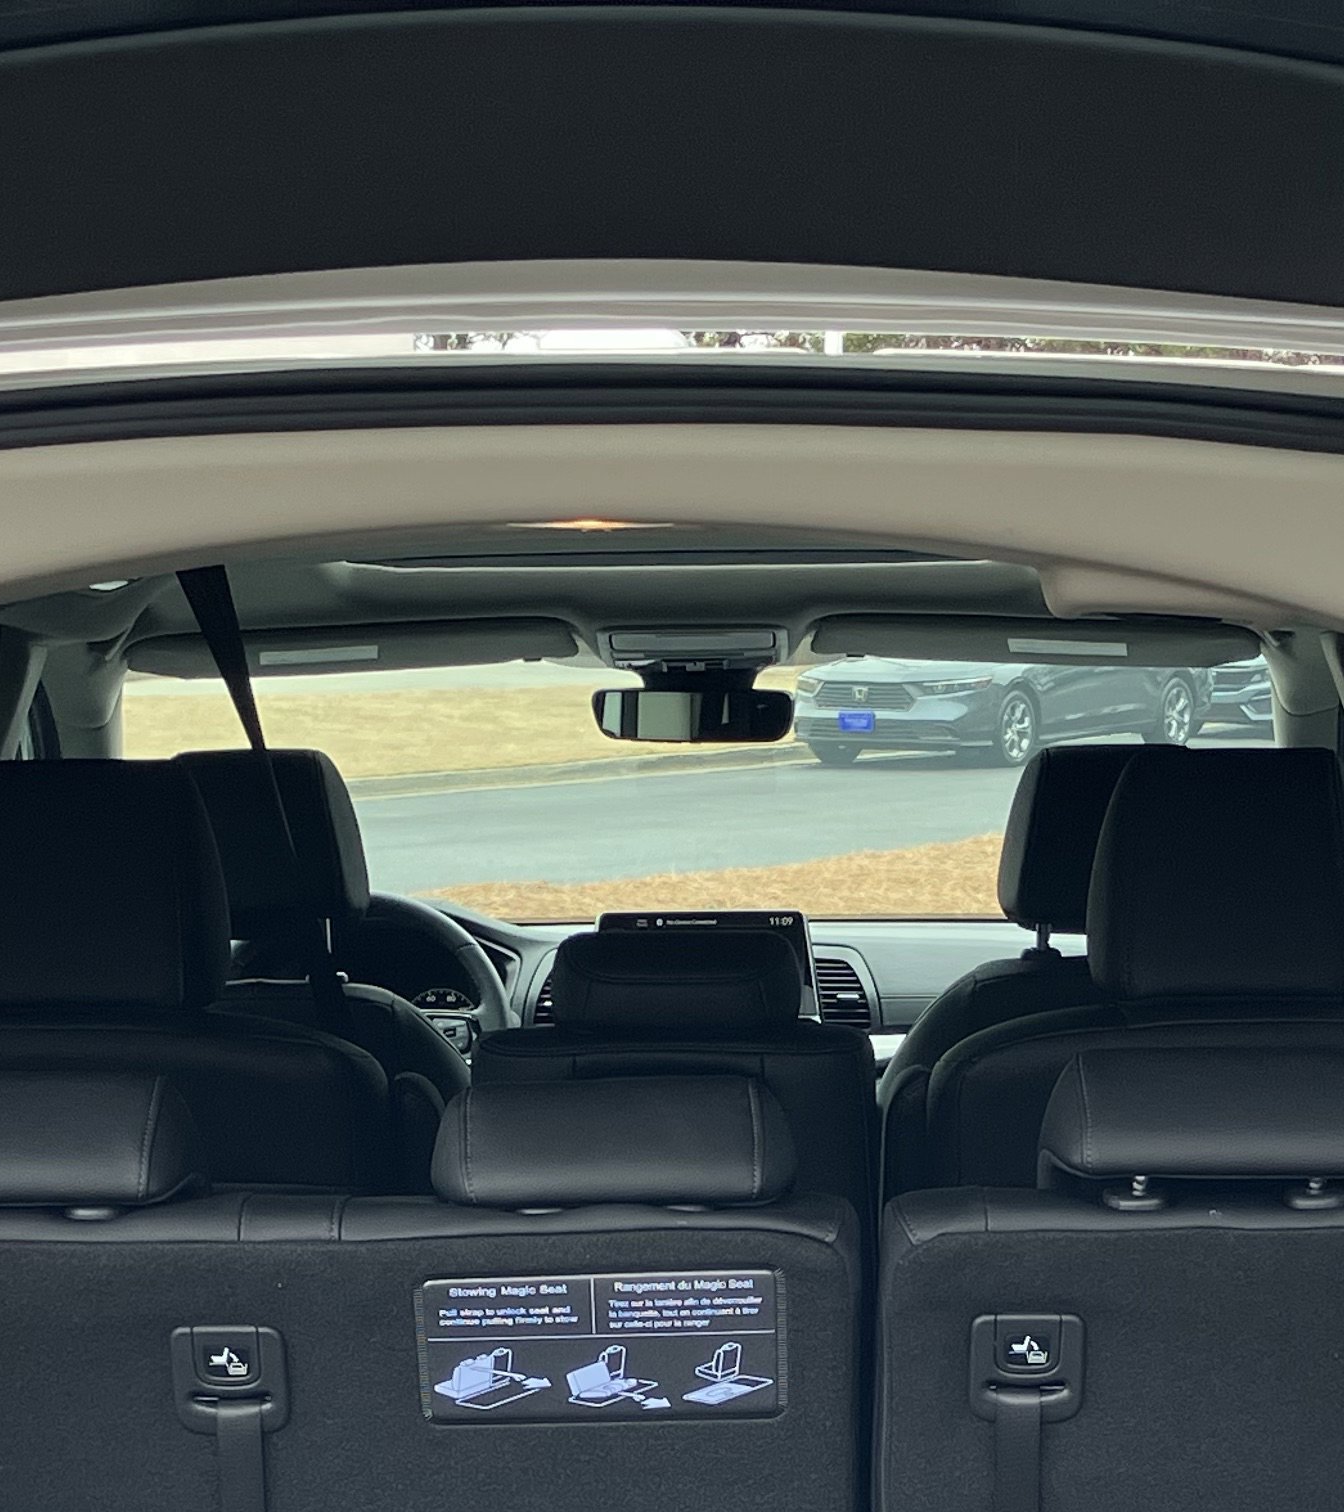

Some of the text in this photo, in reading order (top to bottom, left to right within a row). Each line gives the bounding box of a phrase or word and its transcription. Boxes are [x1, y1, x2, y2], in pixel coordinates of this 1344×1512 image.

[769, 917, 794, 926] 11:09
[614, 1278, 754, 1294] Rangement du Magic Seat
[449, 1284, 567, 1298] Stowing Magic Seat
[485, 1308, 495, 1316] to
[544, 1316, 554, 1324] to
